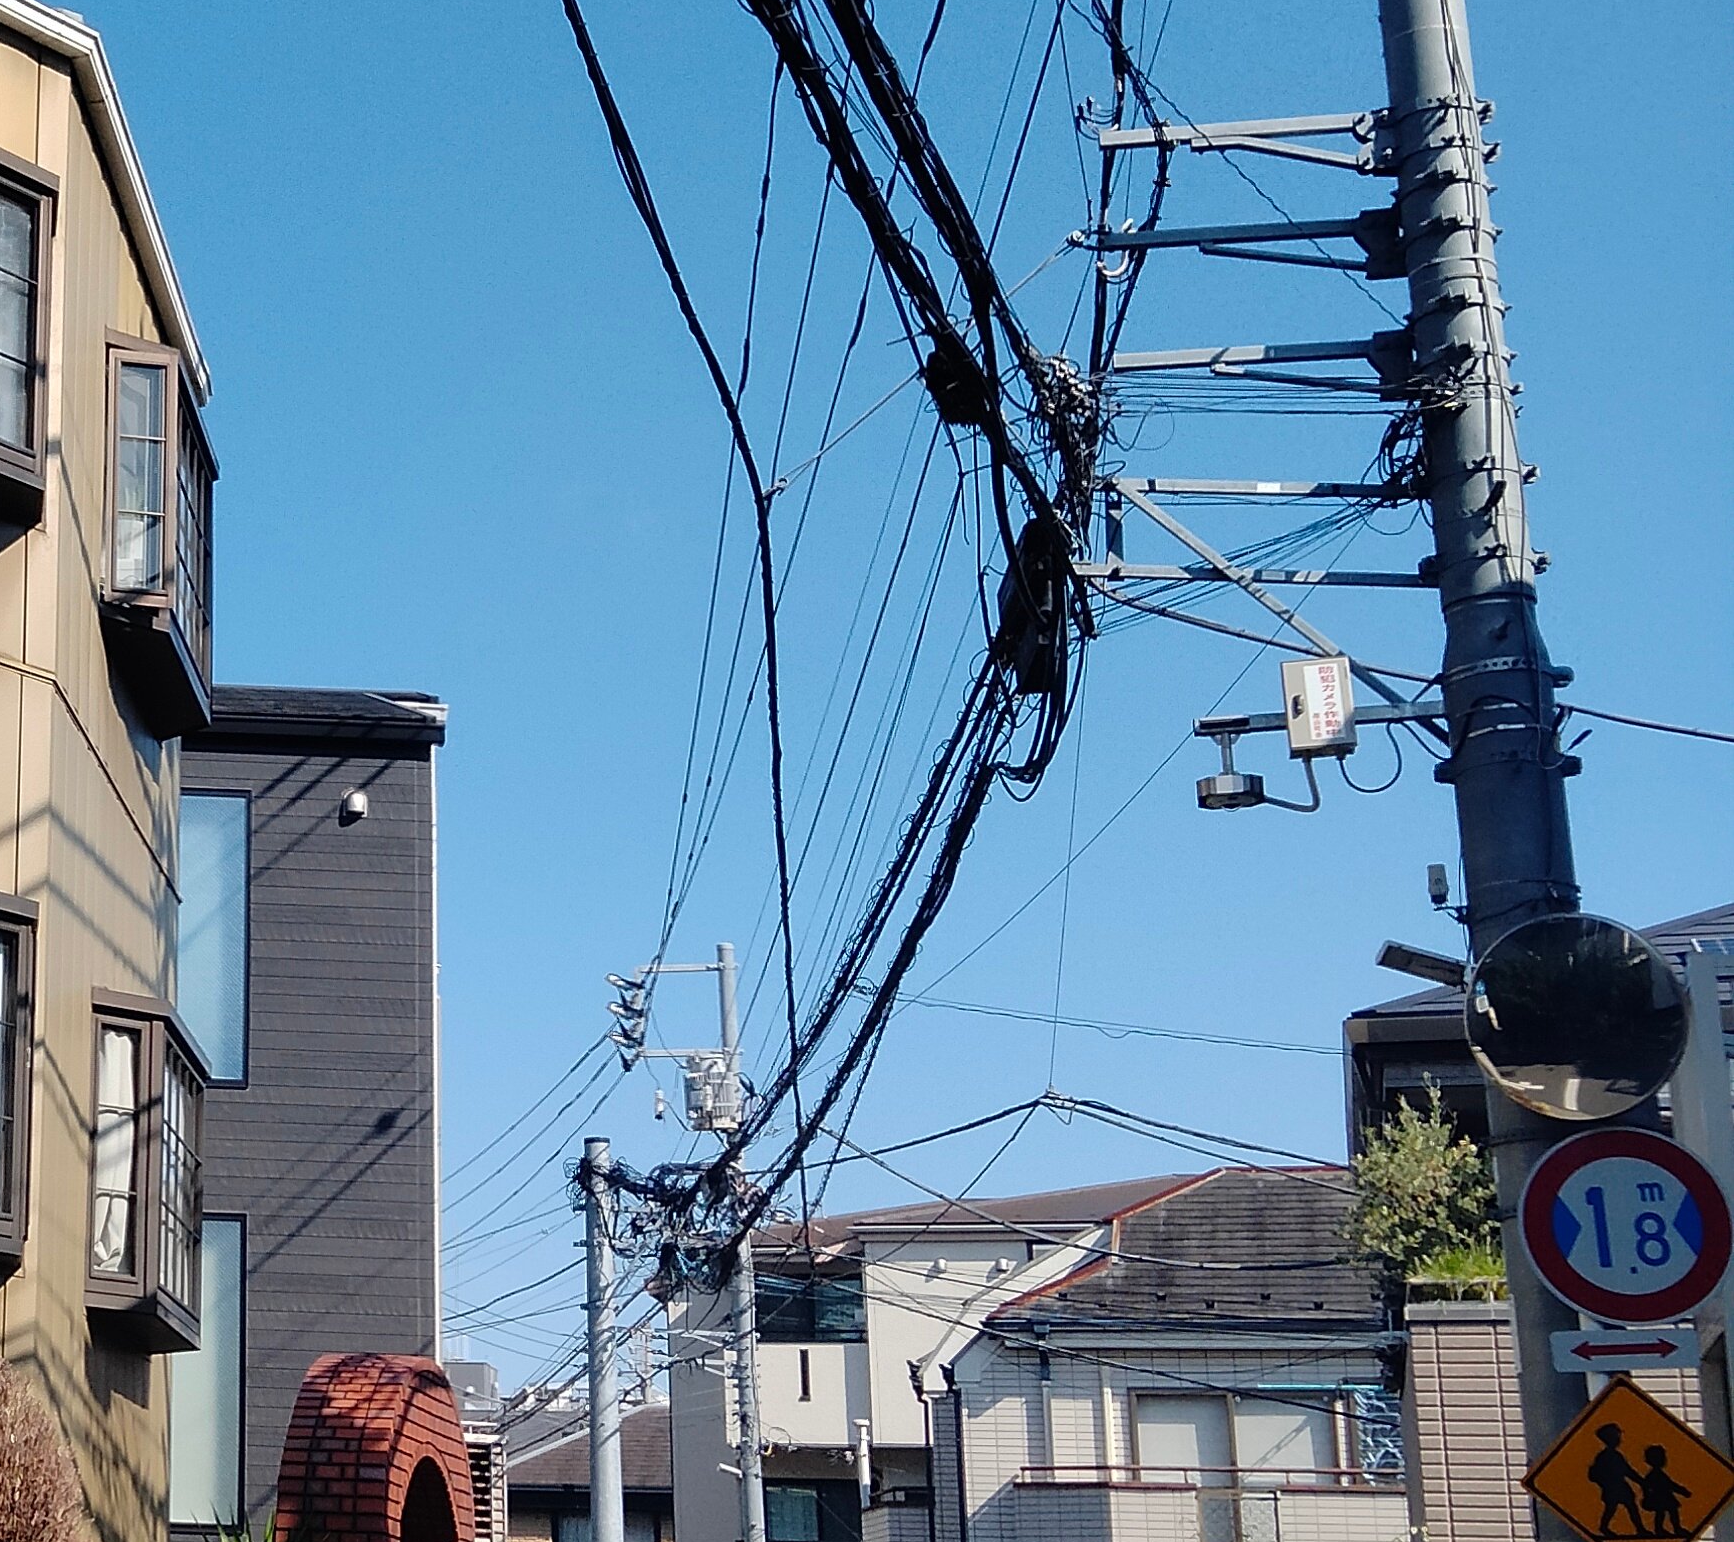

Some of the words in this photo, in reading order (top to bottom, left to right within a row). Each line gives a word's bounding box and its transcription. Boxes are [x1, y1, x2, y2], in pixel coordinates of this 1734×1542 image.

[1318, 665, 1341, 737] 防犯カメラ作動中
